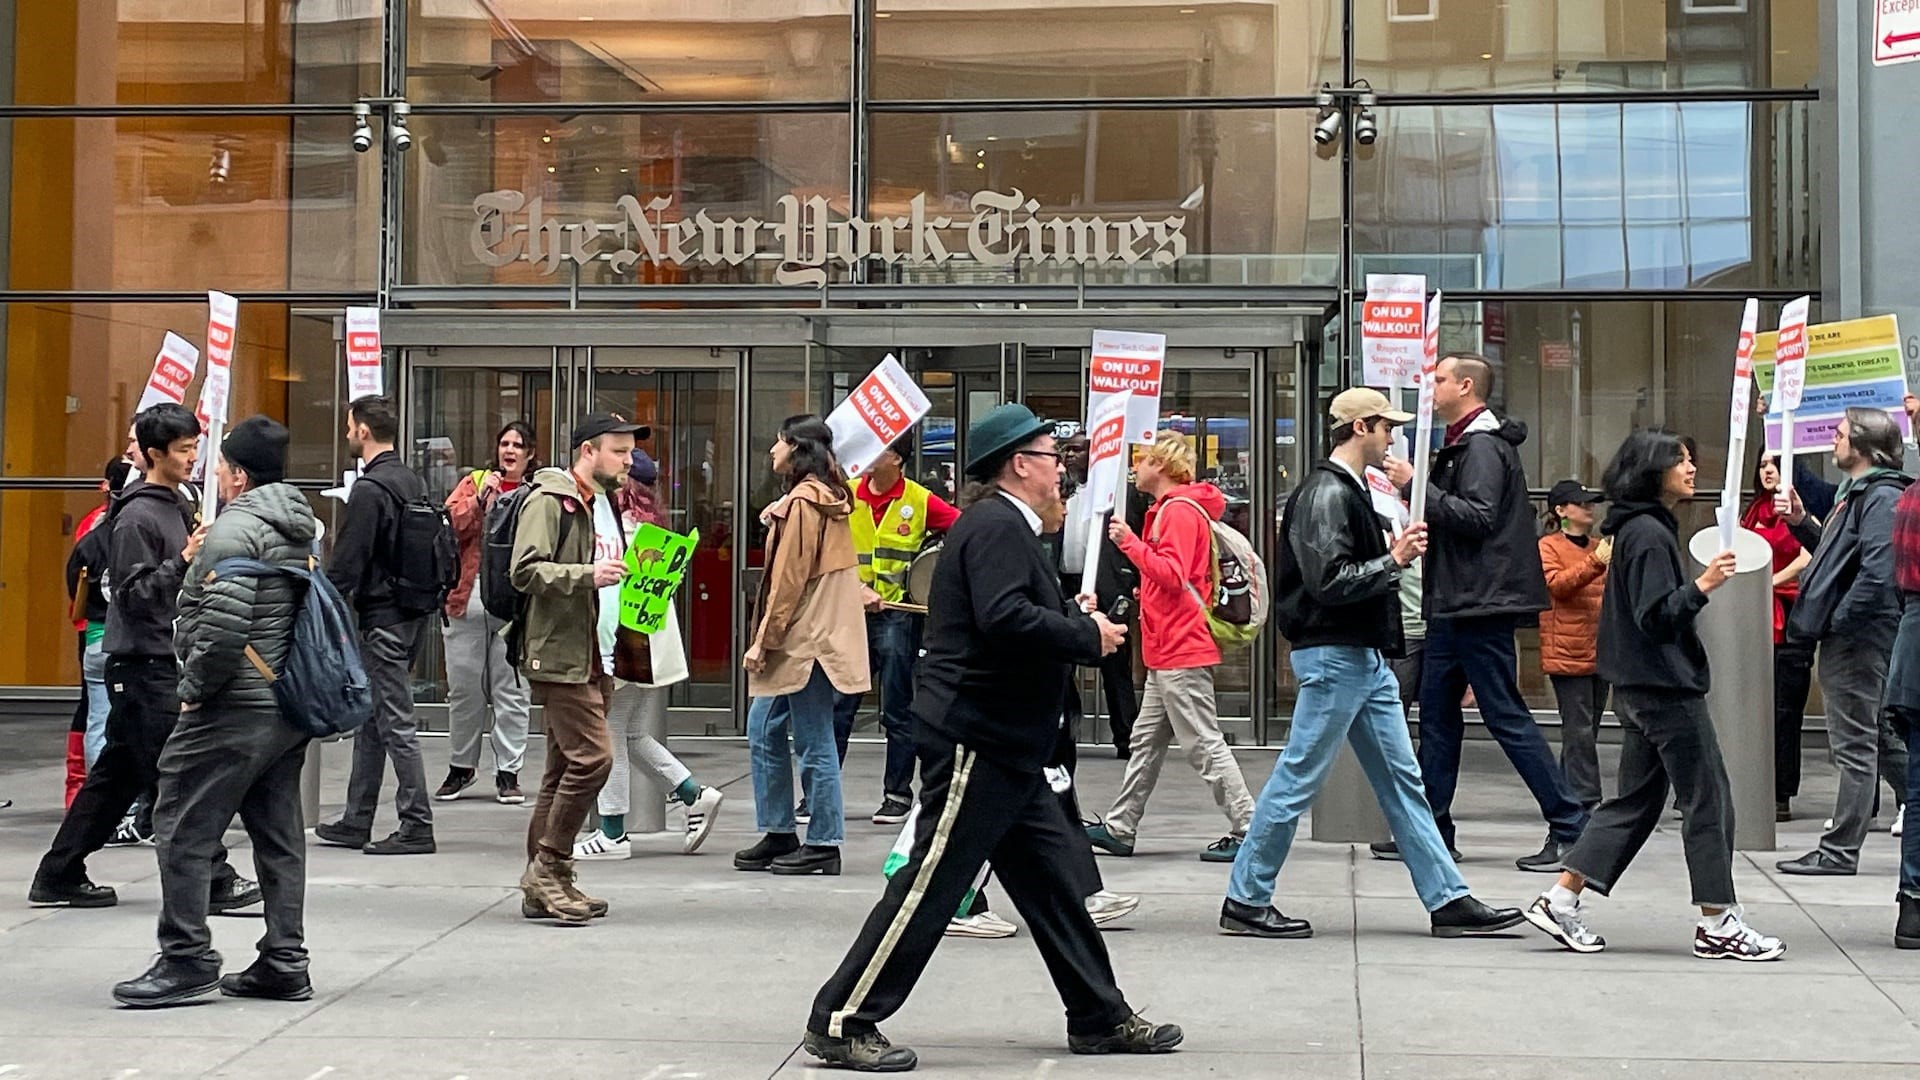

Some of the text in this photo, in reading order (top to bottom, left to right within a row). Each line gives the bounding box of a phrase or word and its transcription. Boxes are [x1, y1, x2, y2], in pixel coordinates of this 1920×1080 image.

[470, 187, 1187, 289] The New York Times
[1371, 306, 1413, 318] ON ULP
[1363, 321, 1420, 334] WALKOUT
[1102, 361, 1151, 375] ON ULP
[1093, 376, 1159, 392] WALKOUT
[869, 385, 901, 422] ON ULP
[855, 390, 896, 439] WALKOUT
